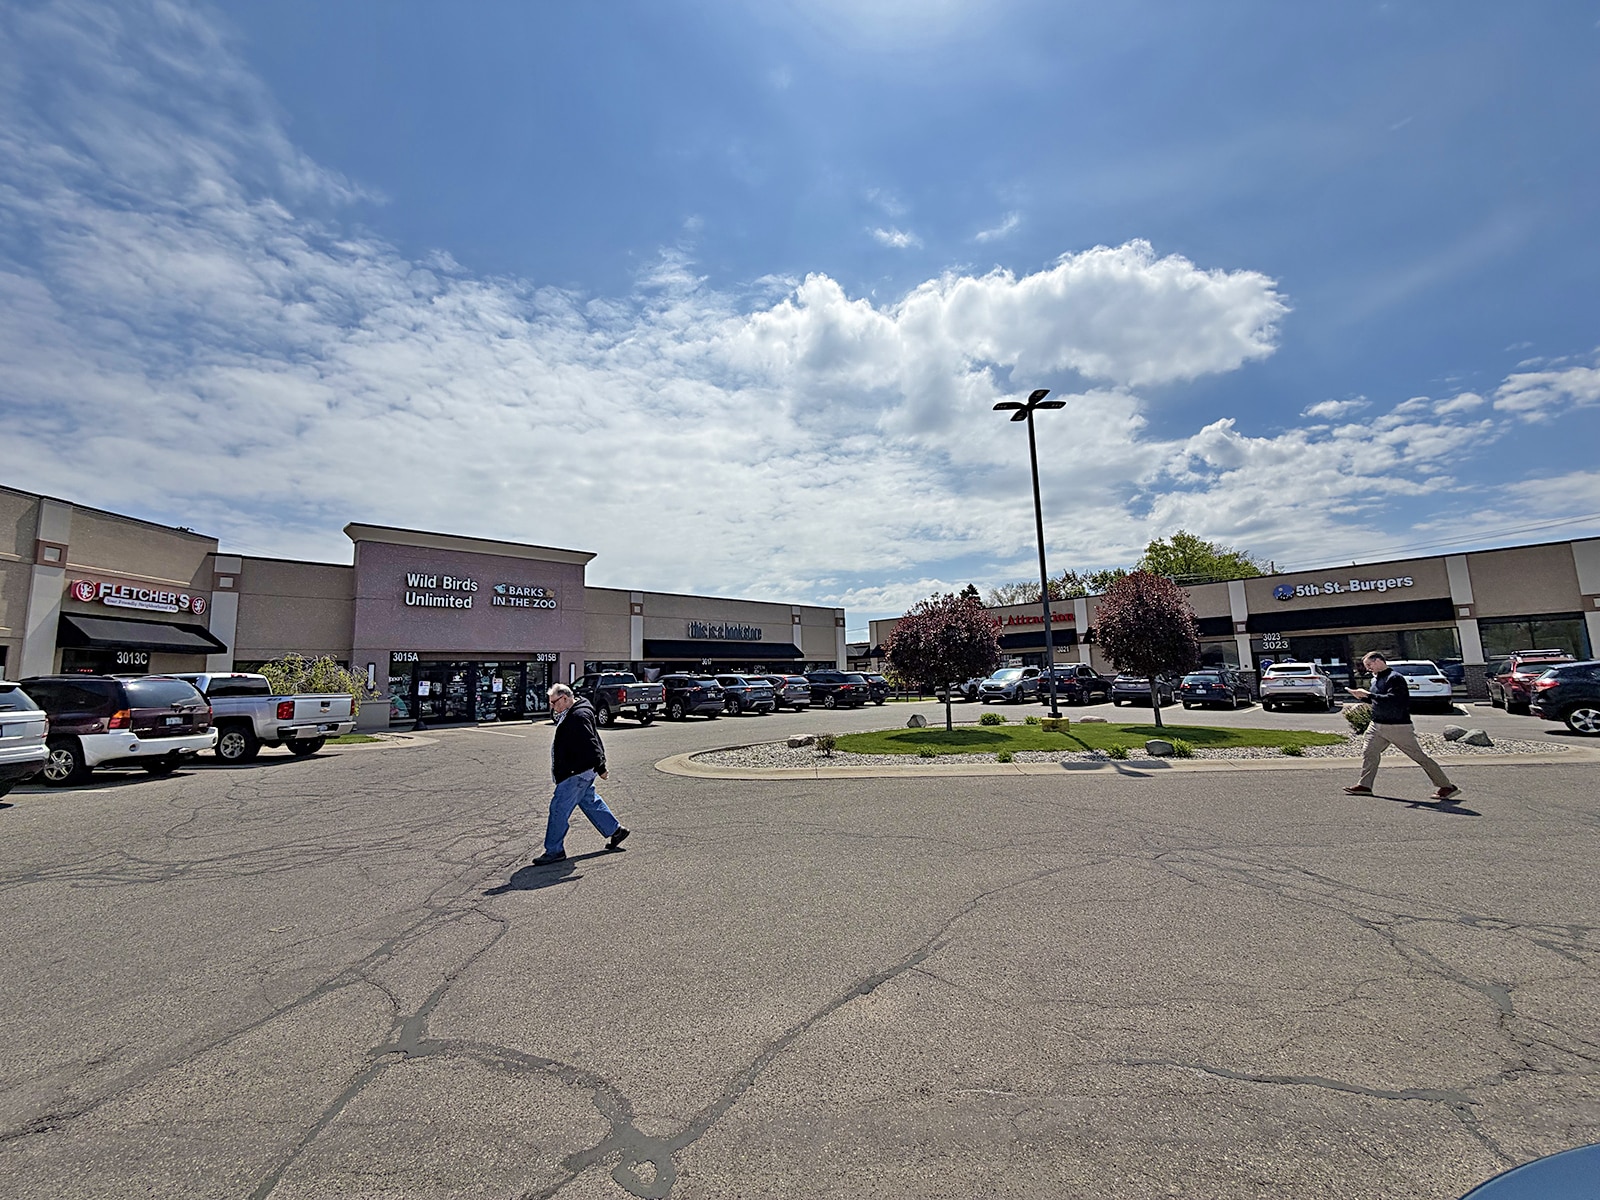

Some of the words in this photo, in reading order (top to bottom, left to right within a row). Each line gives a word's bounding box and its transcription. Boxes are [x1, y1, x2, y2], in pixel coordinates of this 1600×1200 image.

[406, 573, 437, 589] Wild
[442, 575, 479, 592] Birds
[1295, 584, 1320, 597] 5th
[1323, 581, 1345, 594] St.
[1349, 576, 1414, 593] Burgers
[99, 583, 190, 608] FLETCHER'S
[508, 586, 544, 598] BARKS
[405, 591, 473, 609] Unlimited
[493, 596, 506, 606] IN
[509, 597, 530, 607] THE
[533, 599, 557, 609] ZOO
[1005, 611, 1075, 626] Attracion
[1262, 632, 1281, 641] 3023
[1262, 640, 1289, 650] 3023
[116, 651, 148, 665] 3013C
[392, 652, 419, 662] 3015A
[536, 653, 557, 662] 3015B
